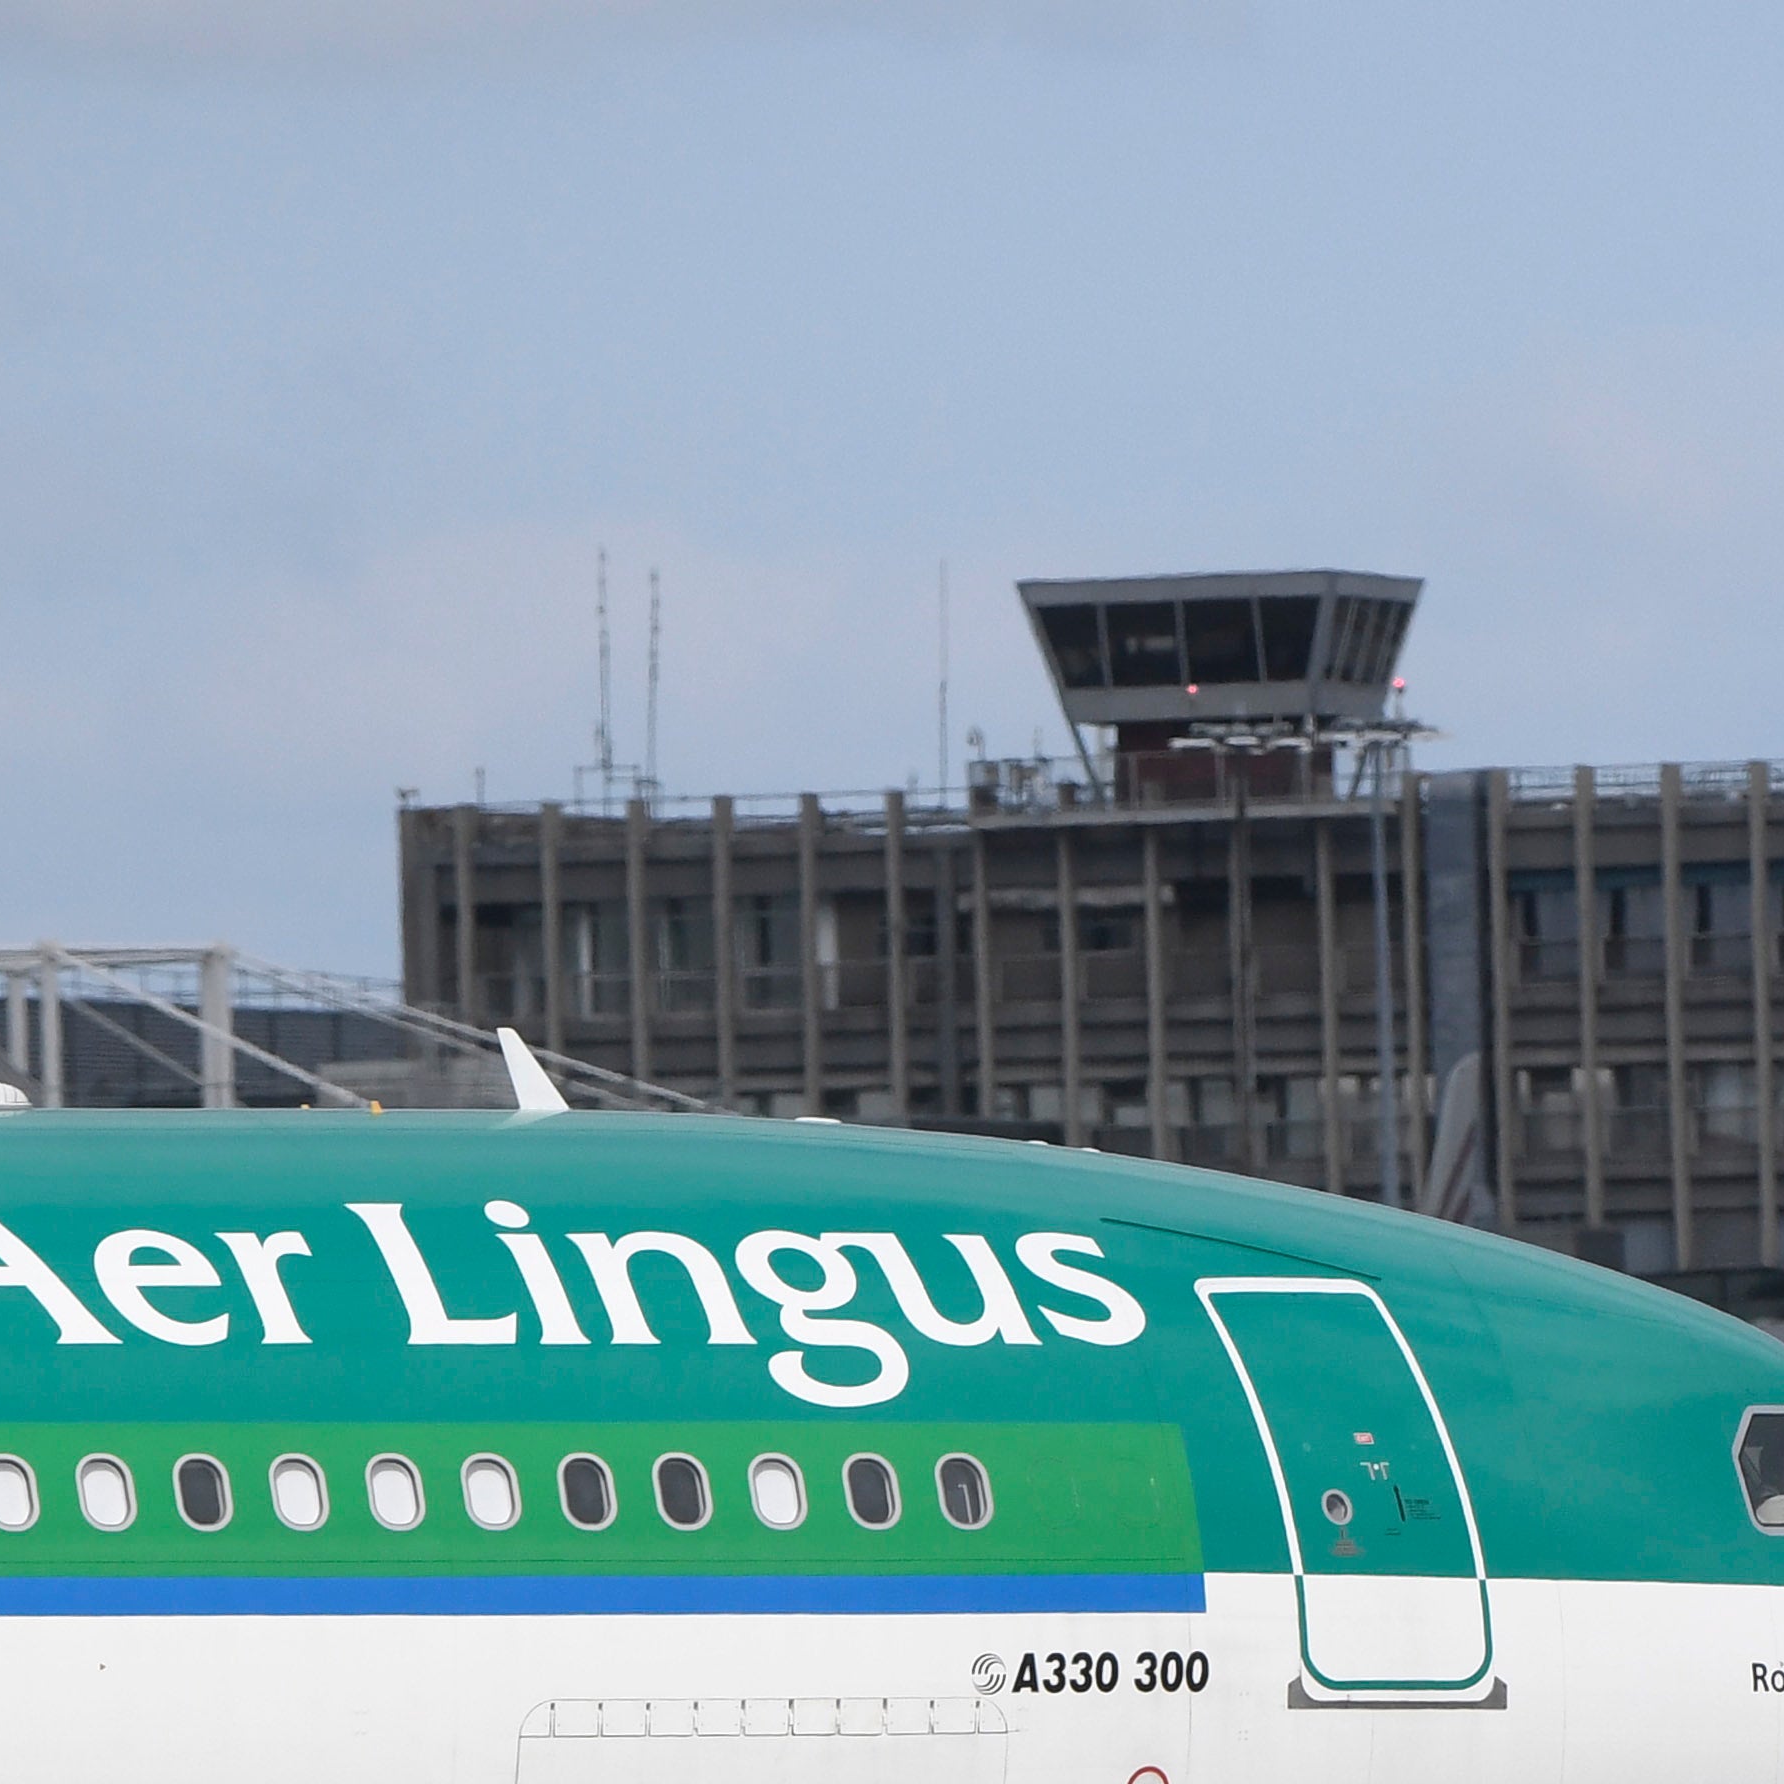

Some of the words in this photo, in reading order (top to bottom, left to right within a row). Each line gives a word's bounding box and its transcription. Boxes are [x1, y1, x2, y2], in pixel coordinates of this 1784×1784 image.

[345, 1200, 1147, 1407] Lingus
[1011, 1651, 1119, 1693] A330
[1134, 1650, 1209, 1693] 300
